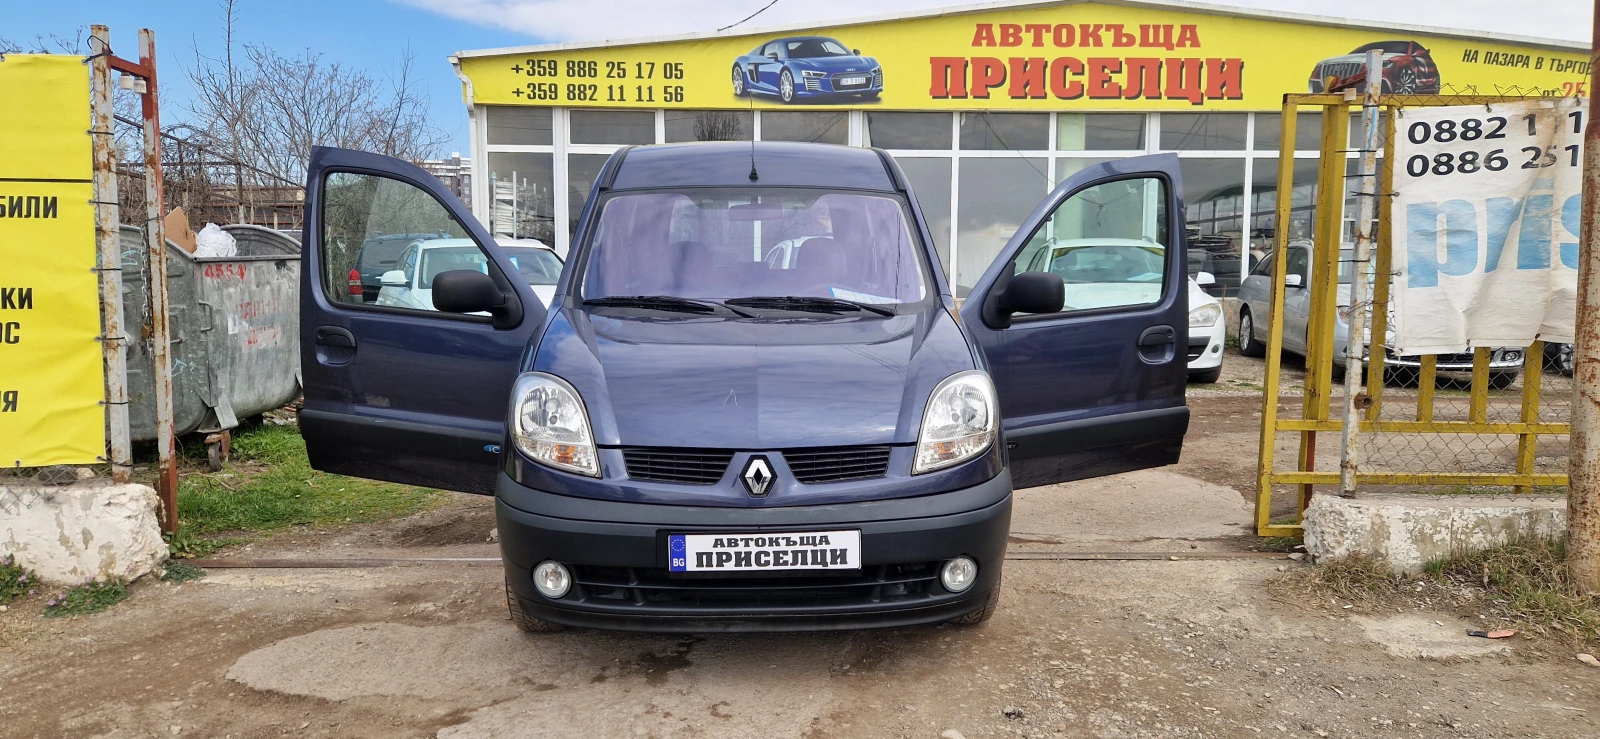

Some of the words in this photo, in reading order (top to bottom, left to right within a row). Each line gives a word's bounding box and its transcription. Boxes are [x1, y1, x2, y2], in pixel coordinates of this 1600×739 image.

[971, 23, 1201, 51] АВТОКЪЩА
[511, 59, 558, 77] +359
[566, 60, 598, 78] 886
[606, 61, 627, 79] 25
[635, 62, 656, 79] 17
[663, 62, 684, 79] 05
[1462, 49, 1479, 63] НА
[1483, 51, 1530, 68] ПАЗАРА
[1534, 56, 1544, 70] В
[929, 57, 1244, 105] ПРИСЕЛЦИ
[512, 83, 559, 100] +359
[566, 84, 598, 101] 882
[607, 84, 626, 102] 11
[635, 85, 655, 102] 11
[663, 86, 684, 102] 56
[1407, 117, 1508, 145] 0882
[1406, 149, 1509, 178] 0886
[712, 535, 831, 549] АВТОКЪЩА
[672, 558, 685, 567] BG
[695, 548, 848, 568] ПРИСЕЛЦИ
